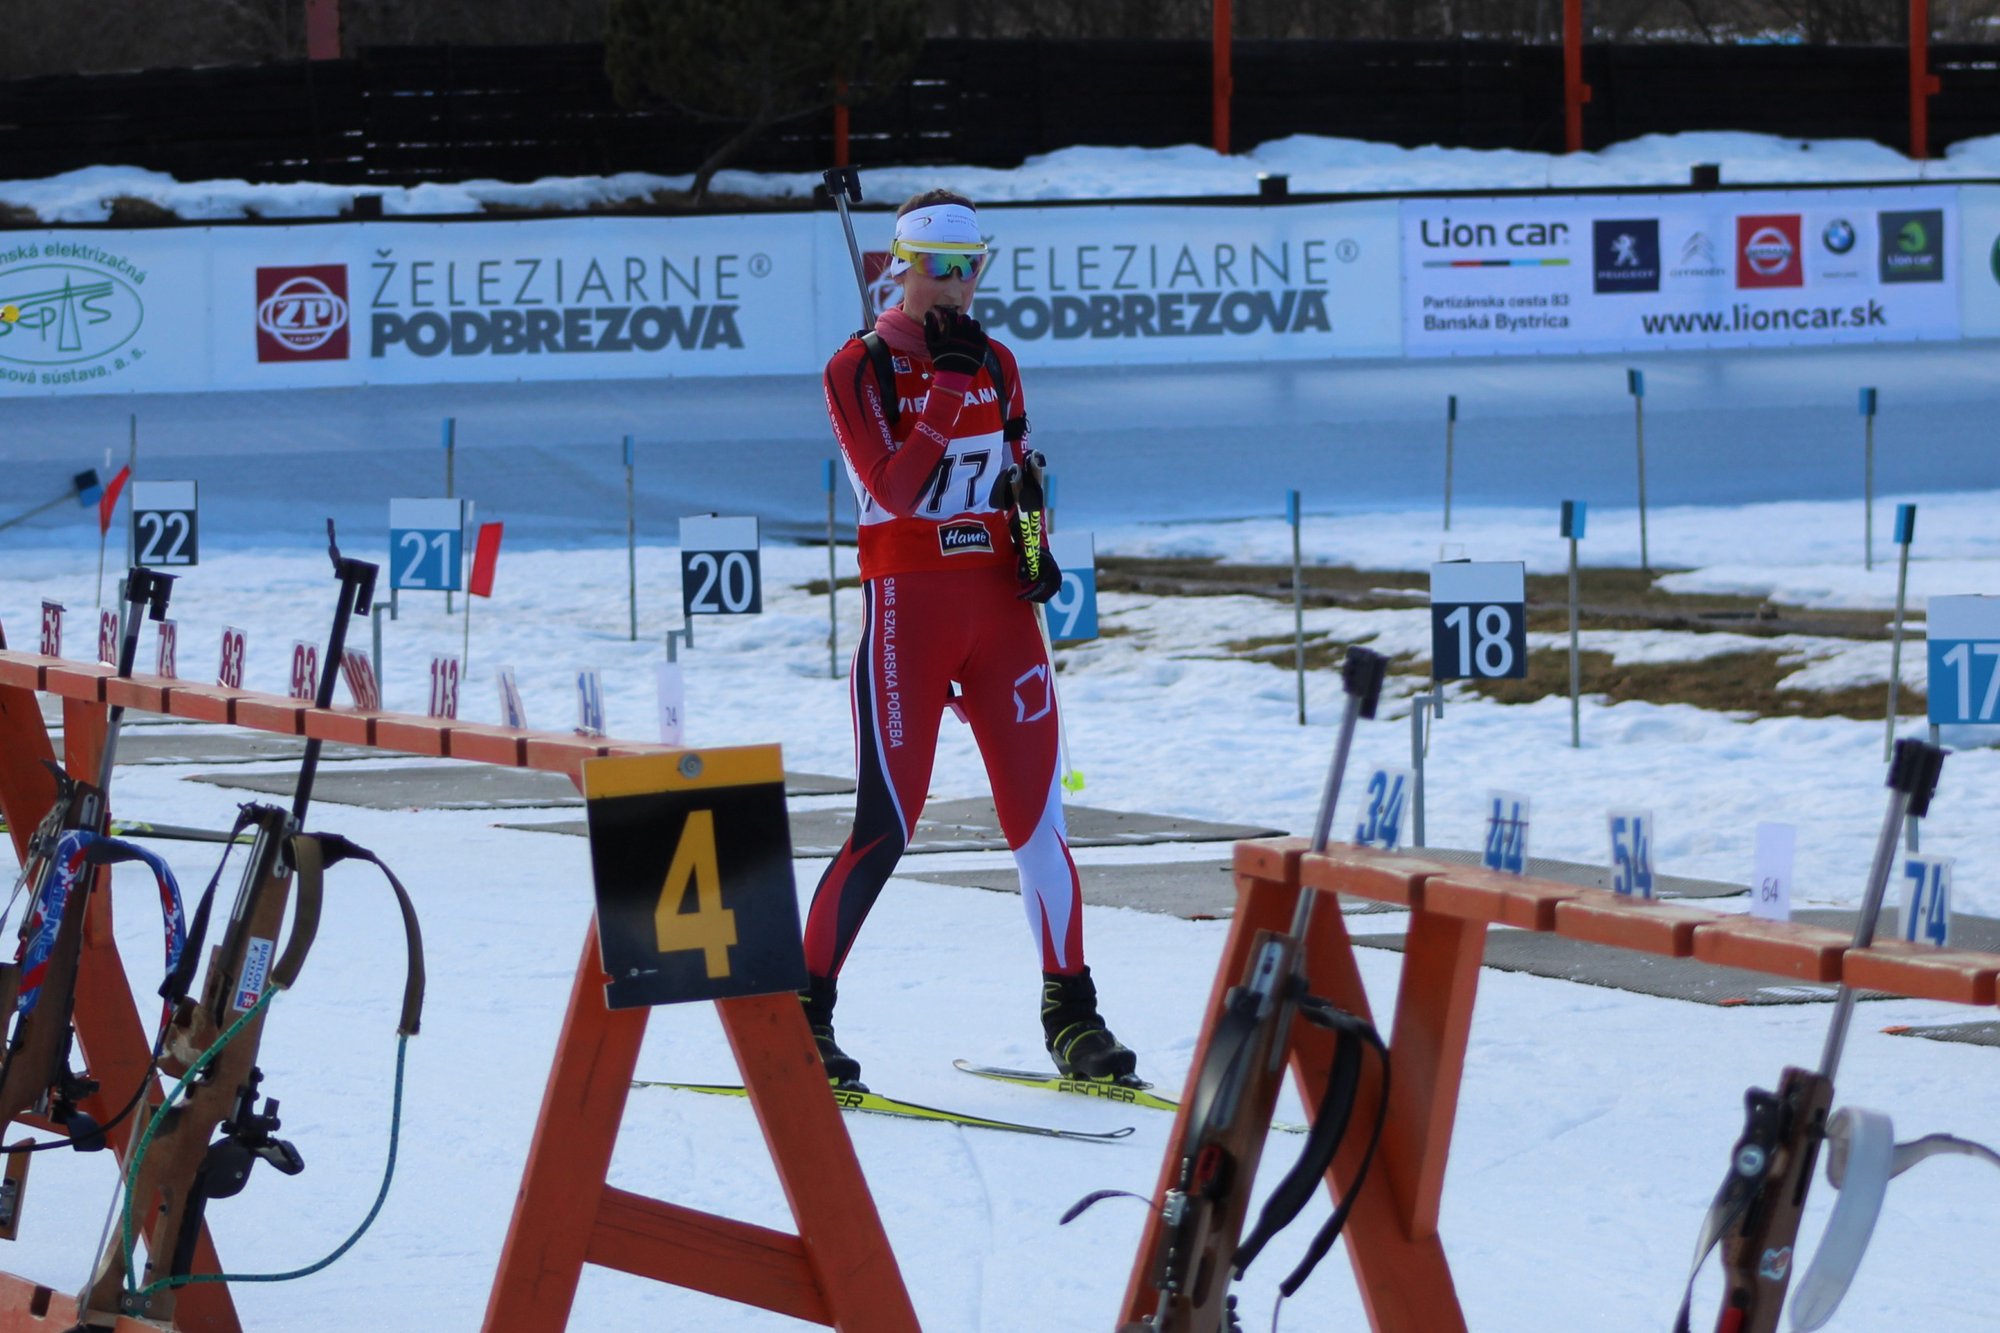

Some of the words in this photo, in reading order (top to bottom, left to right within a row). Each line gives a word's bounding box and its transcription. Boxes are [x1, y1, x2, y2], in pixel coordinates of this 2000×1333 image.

[1420, 216, 1496, 248] Lion
[1506, 222, 1570, 246] car
[1423, 313, 1490, 331] Banská
[1495, 311, 1570, 332] Bystrica
[1508, 295, 1548, 308] cesta
[1641, 299, 1887, 336] www.lioncar.sk
[138, 511, 190, 564] 22
[400, 532, 452, 587] 21
[688, 552, 753, 613] 20
[884, 577, 895, 606] SMS
[1052, 572, 1085, 637] 9
[41, 607, 61, 656] 53
[99, 611, 118, 664] 63
[884, 609, 898, 690] SZKLARSKA
[1443, 605, 1513, 677] 18
[219, 631, 244, 688] 83
[290, 644, 316, 699] 93
[1943, 643, 2000, 720] 17
[430, 657, 459, 719] 113
[1355, 770, 1404, 848] 34
[1484, 797, 1523, 874] 44
[1611, 816, 1652, 898] 54
[654, 810, 738, 979] 4
[1761, 877, 1779, 902] 64
[1905, 860, 1946, 946] 74
[251, 943, 270, 992] BIATLON
[1058, 1079, 1136, 1104] FISCHER
